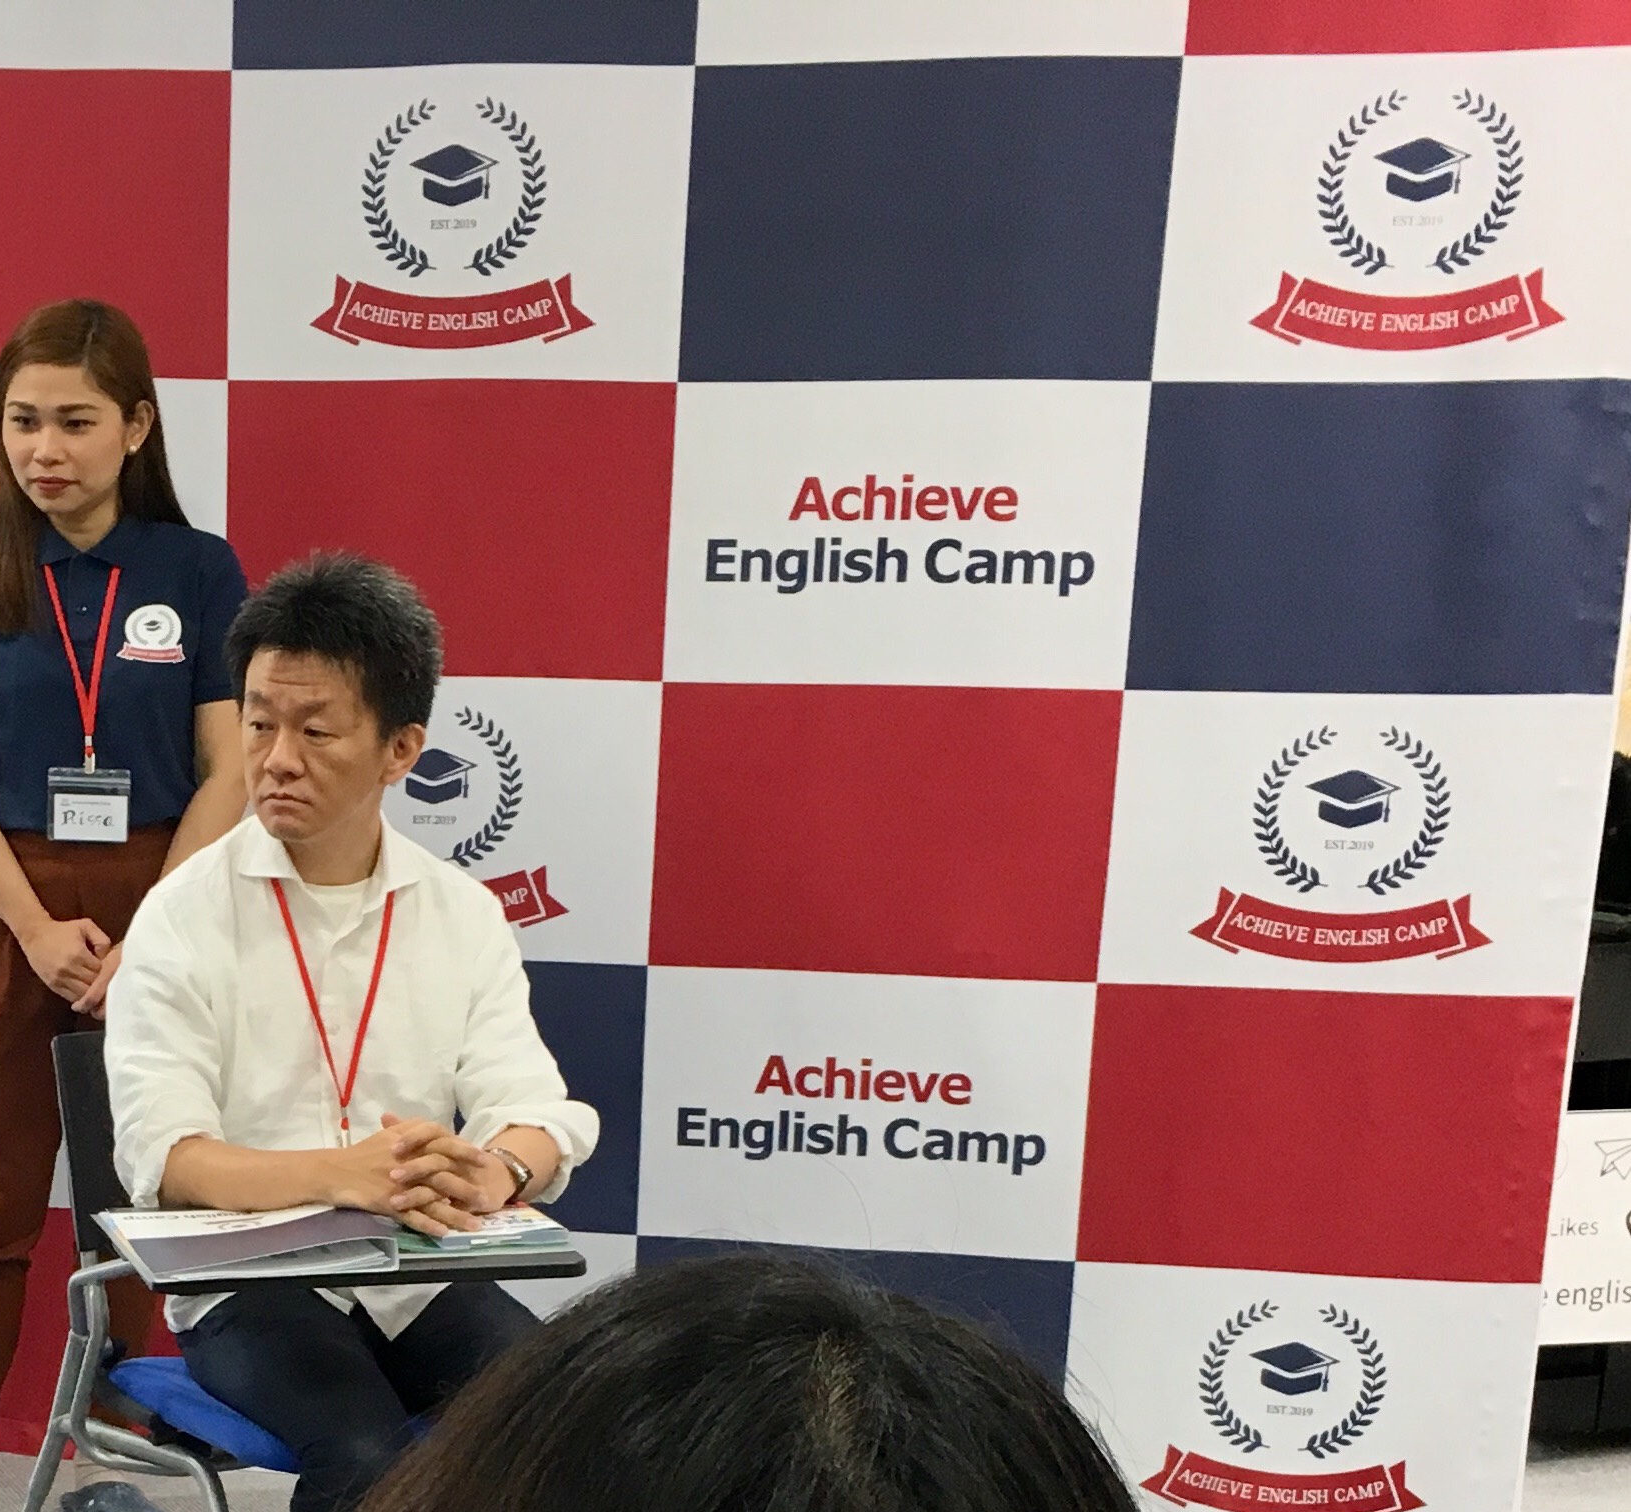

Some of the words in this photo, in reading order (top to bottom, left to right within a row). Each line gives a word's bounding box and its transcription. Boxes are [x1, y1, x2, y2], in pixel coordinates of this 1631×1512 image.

[348, 301, 423, 330] ACHIEVE
[427, 310, 498, 331] ENGLISH
[503, 299, 552, 324] CAMP
[1292, 298, 1375, 331] ACHIEVE
[1380, 310, 1459, 332] ENGLISH
[1465, 294, 1519, 325] CAMP
[788, 474, 1018, 522] Achieve
[705, 536, 908, 594] English
[924, 538, 1096, 598] Camp
[503, 887, 528, 907] MP
[1230, 911, 1309, 943] ACHIEVE
[1314, 927, 1390, 946] ENGLISH
[1394, 917, 1448, 943] CAMP
[754, 1054, 973, 1106] Achieve
[676, 1107, 868, 1161] English
[883, 1117, 1046, 1176] Camp
[1177, 1468, 1253, 1500] ACHIEVE
[1257, 1485, 1328, 1505] ENGLISH
[1334, 1481, 1384, 1501] CAMP
